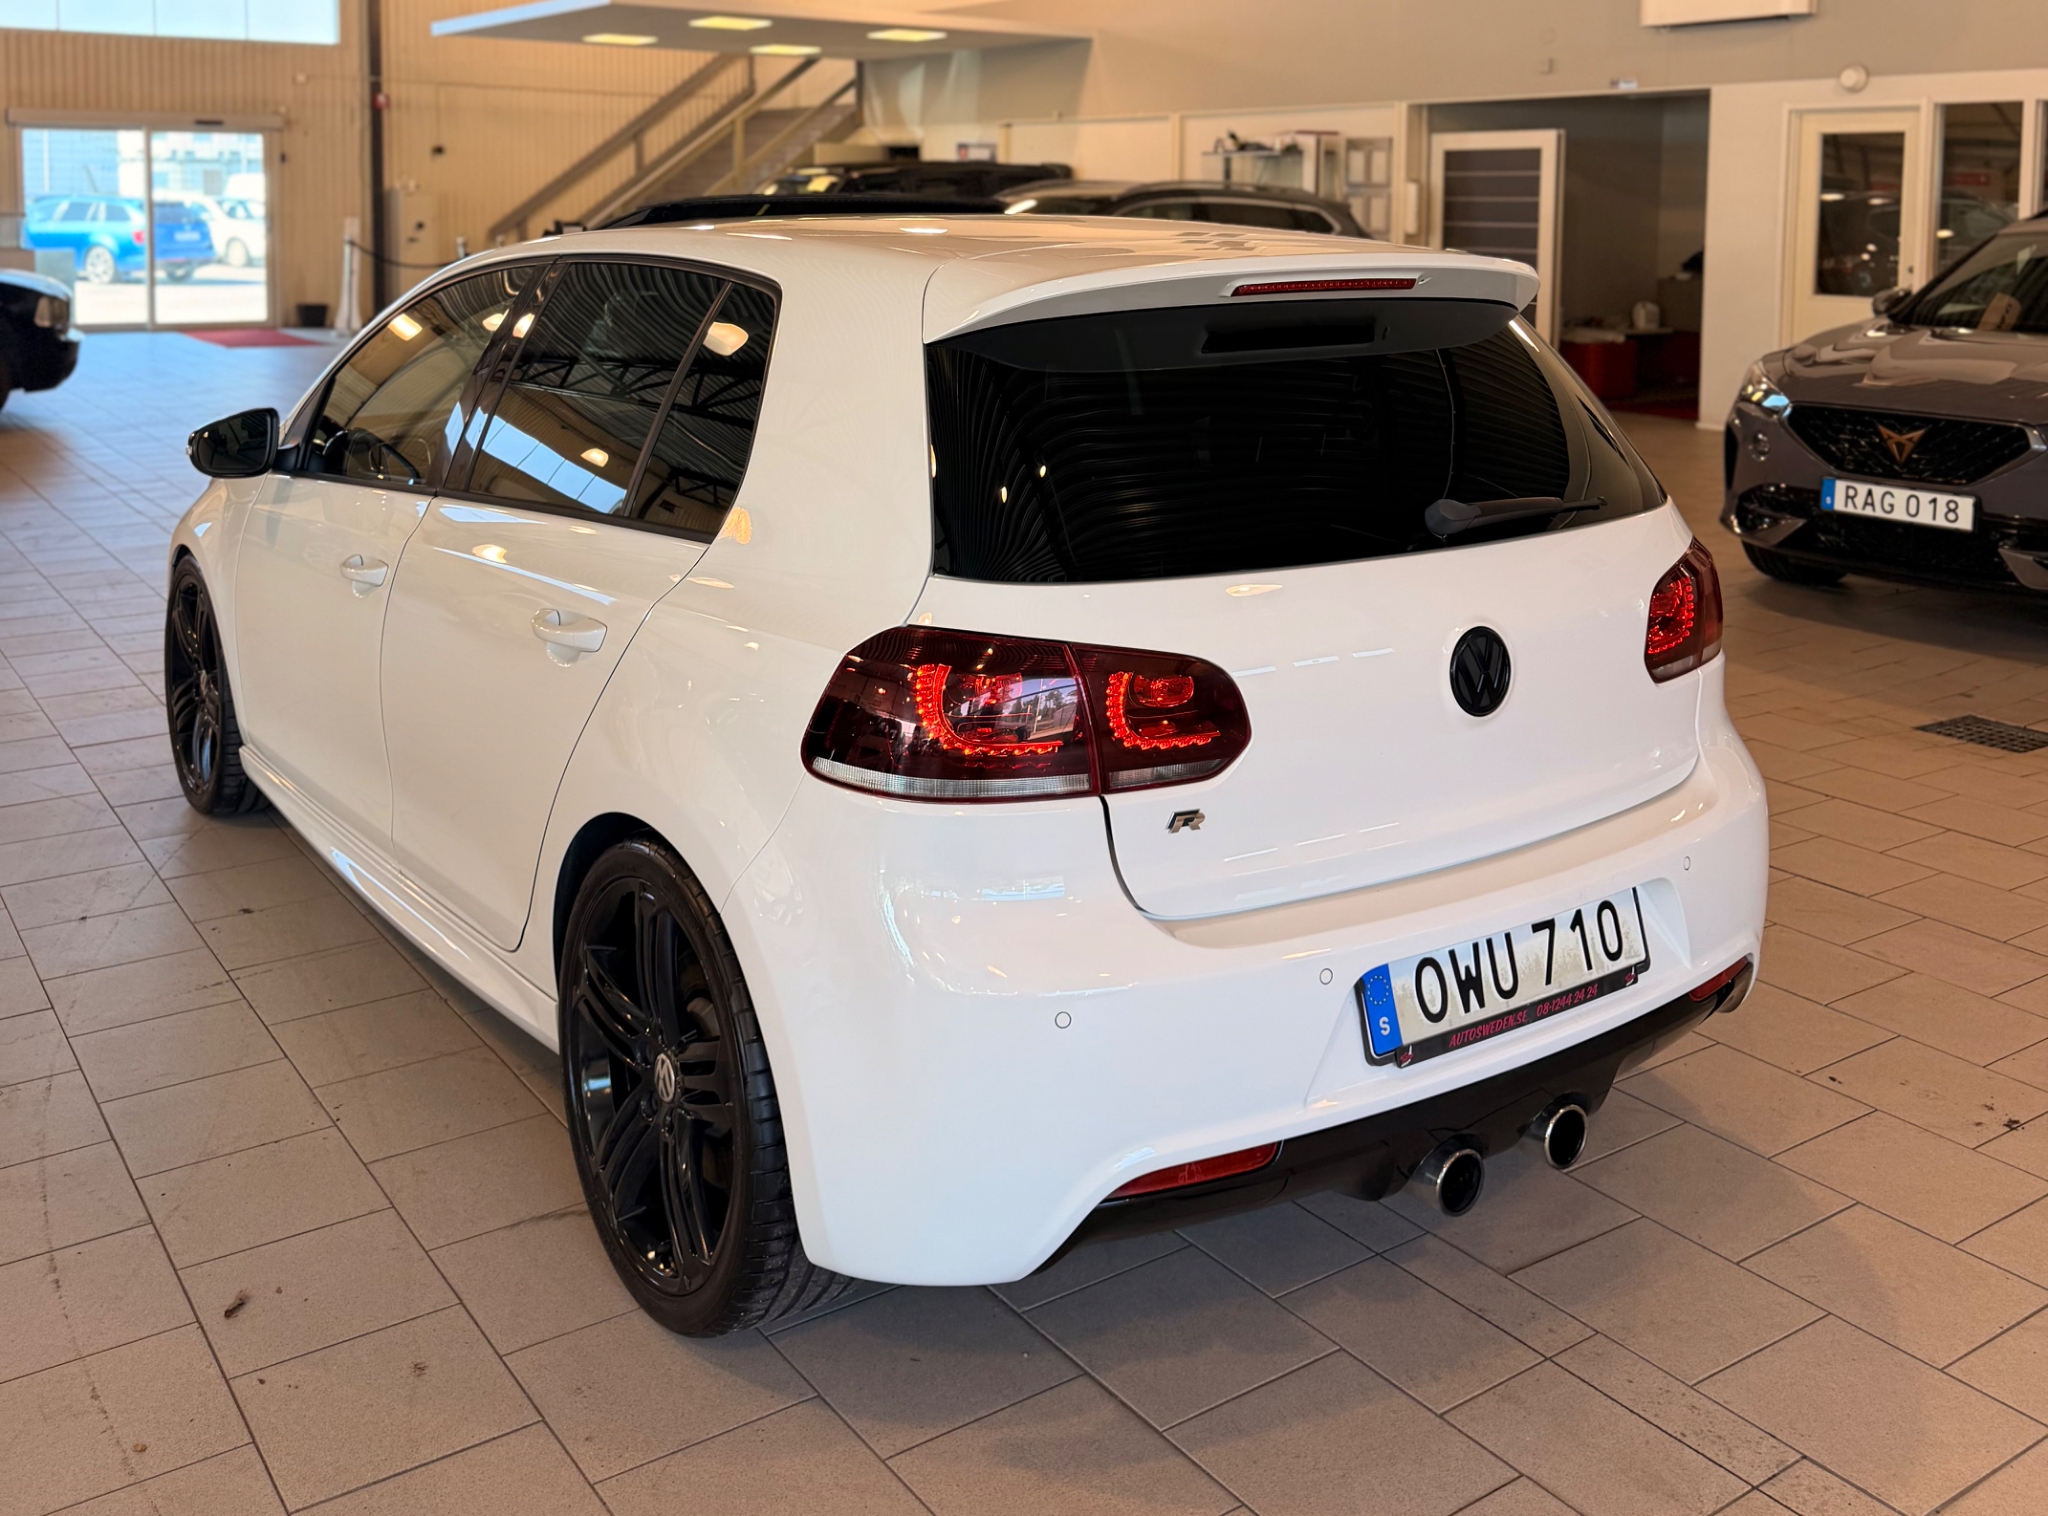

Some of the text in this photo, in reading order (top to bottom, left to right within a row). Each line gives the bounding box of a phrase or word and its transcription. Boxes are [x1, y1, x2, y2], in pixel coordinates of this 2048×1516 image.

[1844, 484, 1960, 524] RAG 018
[1165, 808, 1206, 834] R
[1414, 899, 1624, 1024] OWU 710
[1378, 1015, 1391, 1036] S
[1448, 983, 1598, 1047] AUTOSWEDEN.SE 08-1244 24 24
